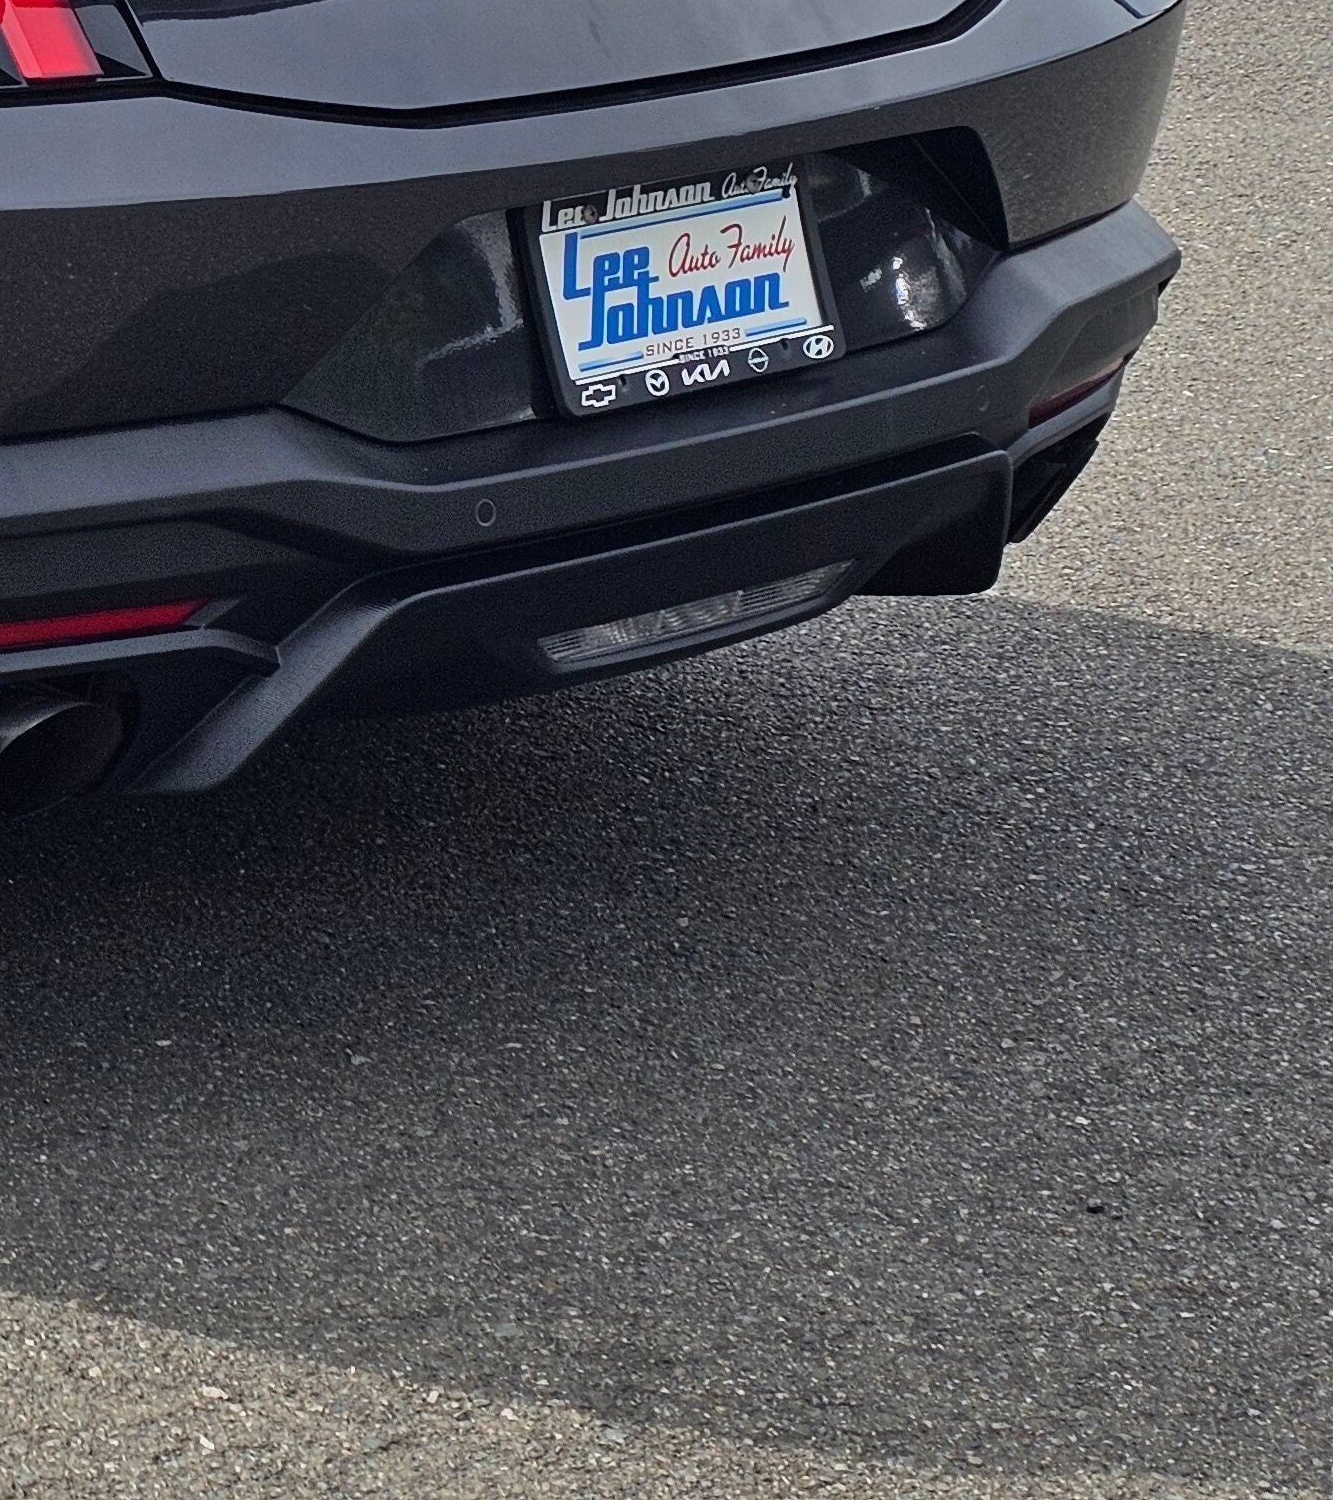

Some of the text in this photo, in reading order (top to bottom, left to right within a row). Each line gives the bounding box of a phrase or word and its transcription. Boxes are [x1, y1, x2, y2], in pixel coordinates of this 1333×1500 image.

[599, 181, 715, 222] Johnson
[722, 172, 750, 198] Aut
[563, 215, 795, 300] Lee Auto Family
[578, 272, 790, 352] Johnson
[645, 327, 741, 358] SINCE 1933
[678, 350, 707, 363] SINCE
[682, 359, 730, 386] KIA
